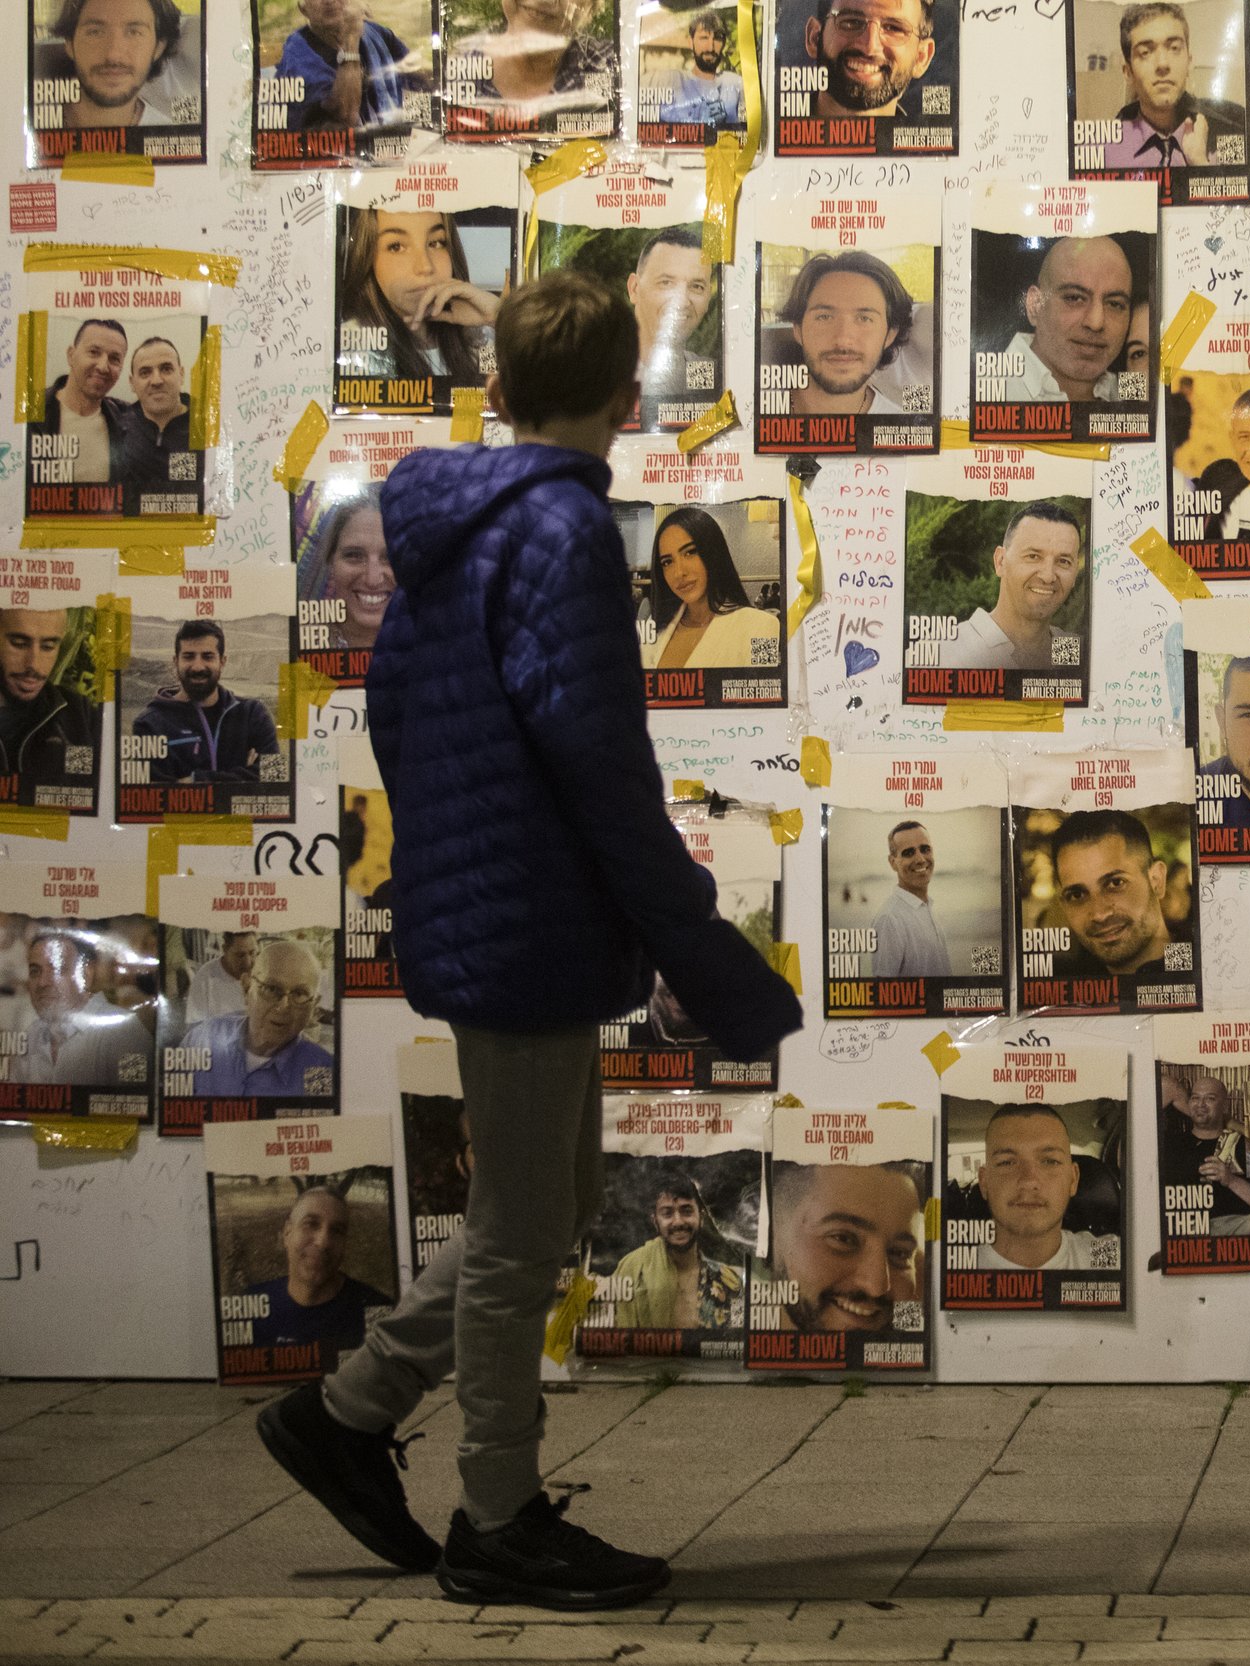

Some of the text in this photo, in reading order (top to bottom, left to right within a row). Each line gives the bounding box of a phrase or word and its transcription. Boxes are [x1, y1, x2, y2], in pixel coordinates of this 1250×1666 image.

[780, 67, 828, 93] BRING
[780, 91, 811, 118] HIM
[780, 119, 875, 144] HOME NOW!
[395, 178, 459, 192] AGAM BERGER
[417, 193, 436, 208] (19)
[820, 200, 878, 214] עומר שם טוב
[1038, 203, 1073, 216] SHLOMI
[810, 215, 885, 229] OMER SHEM TOV
[1052, 218, 1073, 232] (40)
[838, 231, 857, 247] (21)
[54, 291, 182, 308] ELI AND YOSSI SHARABI
[1207, 340, 1242, 353] ALKADI
[760, 364, 808, 390] BRING
[760, 389, 791, 415] HIM
[760, 416, 855, 442] HOME NOW!
[855, 457, 888, 477] הלב
[963, 466, 1036, 481] YOSSI SHARABI
[989, 481, 1009, 497] (53)
[839, 570, 893, 588] בשלום
[178, 585, 233, 600] IDAN SHTIVI
[195, 601, 215, 615] (28)
[908, 615, 959, 642] BRING
[908, 640, 942, 667] HIM
[908, 669, 1004, 694] HOME NOW!
[1022, 686, 1082, 699] FAMILIES FORUM
[892, 761, 937, 776] עמרי מירן
[886, 777, 943, 791] OMRI MIRAN
[1071, 776, 1136, 790] URIEL BARUCH
[904, 793, 925, 807] (46)
[1094, 790, 1114, 807] (35)
[212, 898, 288, 913] AMIRAM COOPER
[1198, 1039, 1218, 1054] IAIR
[1220, 1039, 1239, 1053] AND
[993, 1068, 1076, 1083] BAR KUPERSHTEIN
[1024, 1083, 1045, 1100] (22)
[803, 1130, 874, 1144] ELIA TOLEDANO
[829, 1145, 849, 1160] (27)
[1165, 1185, 1213, 1209] BRING
[1165, 1209, 1210, 1235] THEM
[946, 1219, 996, 1245] BRING
[946, 1244, 978, 1270] HIM
[1167, 1239, 1211, 1263] HOME
[749, 1280, 799, 1305] BRING
[946, 1273, 1043, 1298] HOME NOW!
[749, 1304, 780, 1330] HIM
[749, 1334, 845, 1359] HOME NOW!
